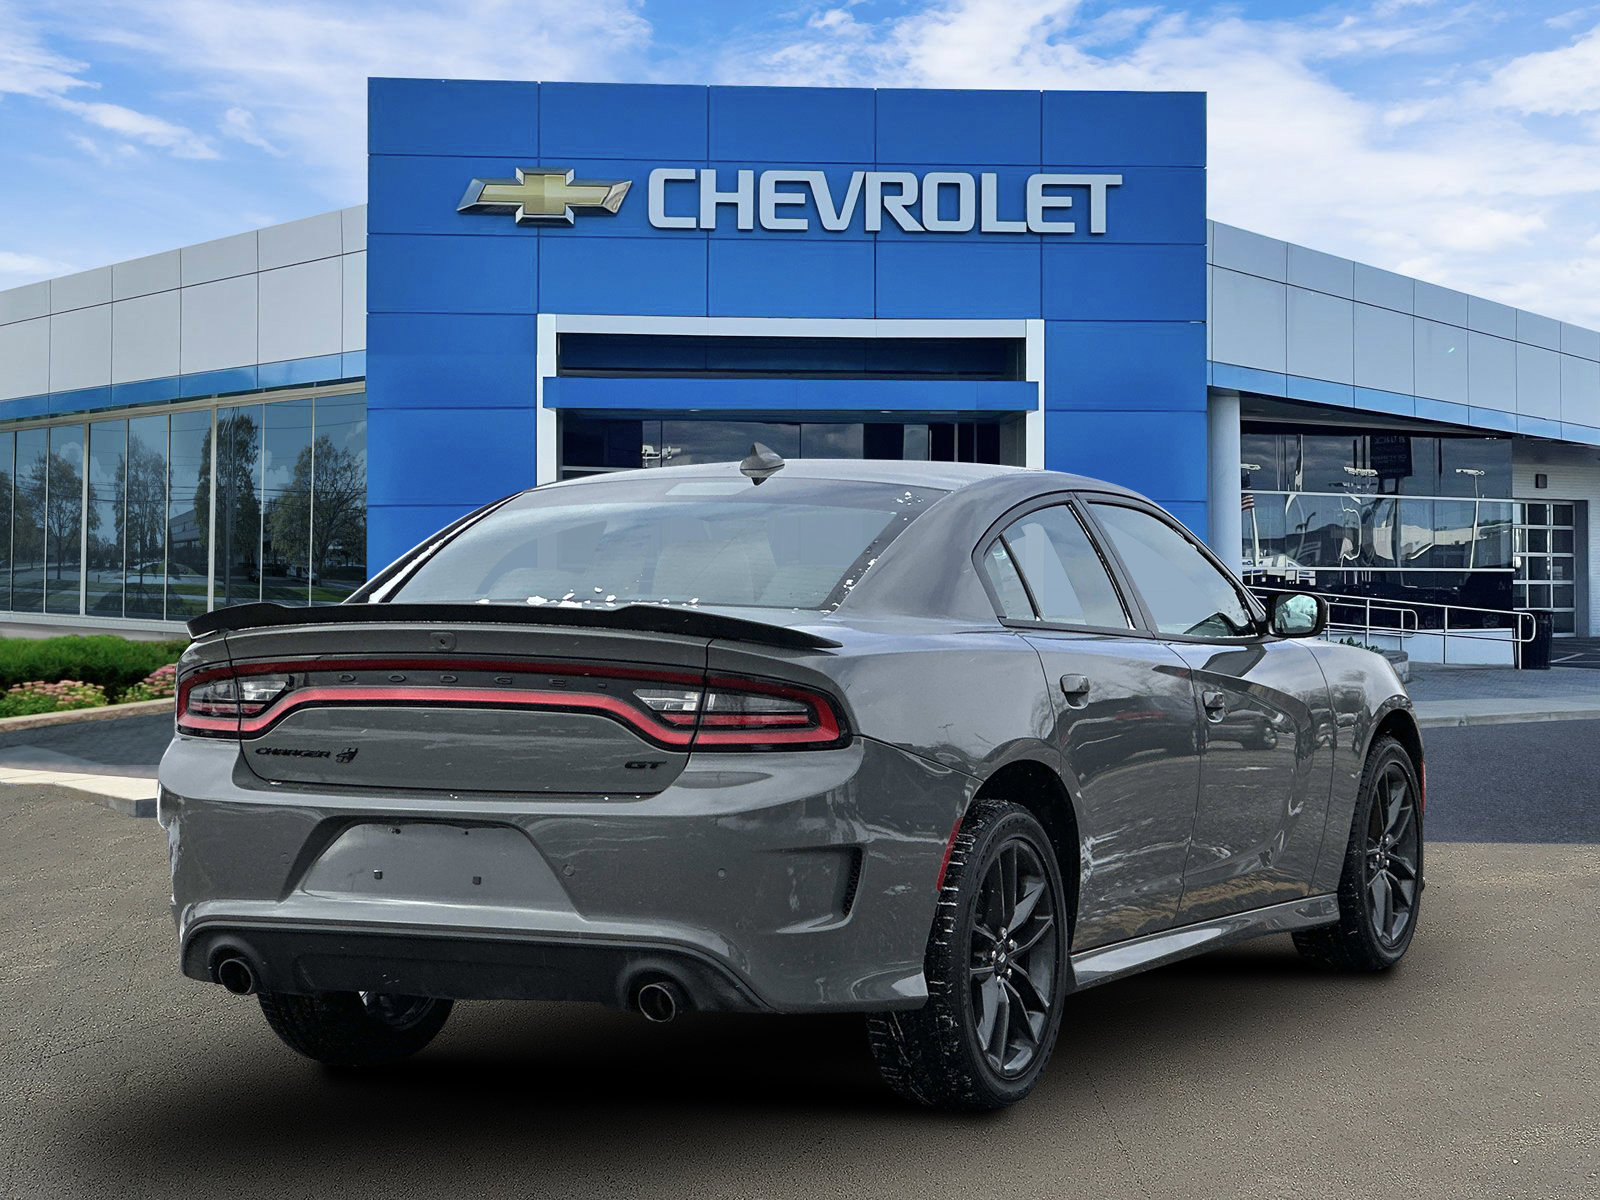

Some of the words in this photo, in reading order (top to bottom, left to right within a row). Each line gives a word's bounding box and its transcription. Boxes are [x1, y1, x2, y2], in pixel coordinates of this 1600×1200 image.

[648, 167, 1124, 235] CHEVROLET
[338, 673, 567, 688] DODGE
[255, 747, 331, 758] CHARGER
[624, 760, 668, 769] GT
